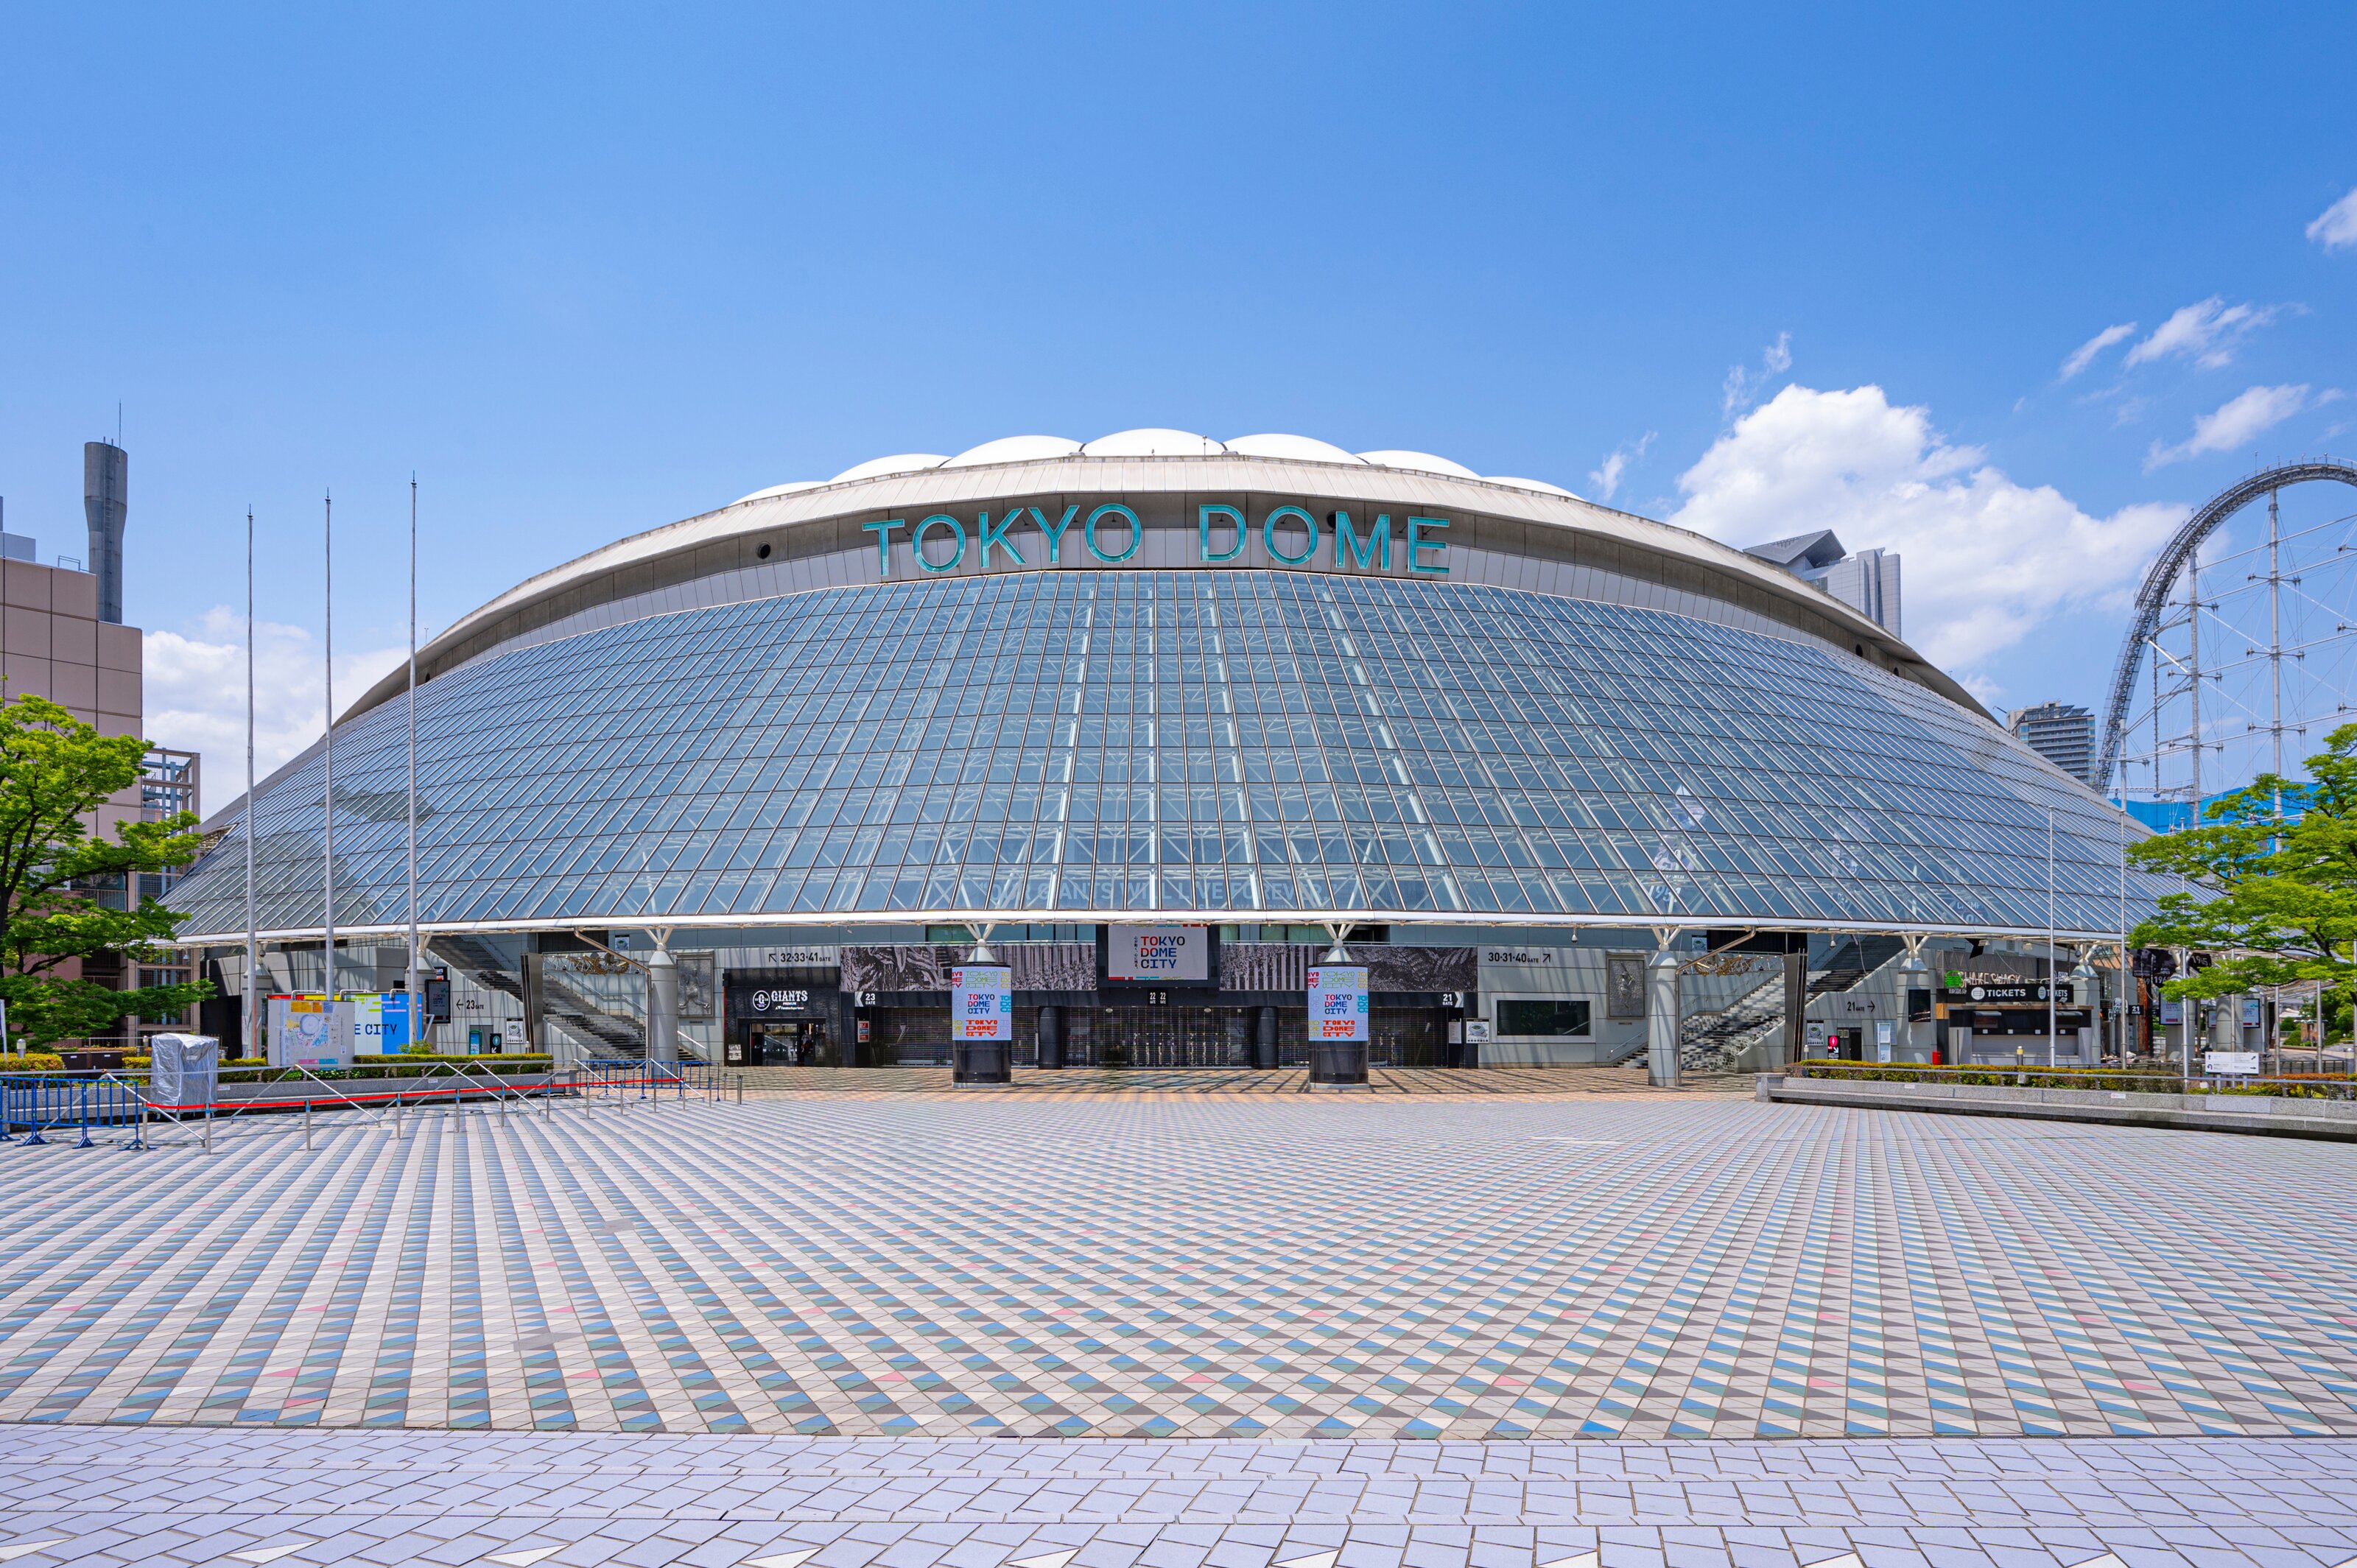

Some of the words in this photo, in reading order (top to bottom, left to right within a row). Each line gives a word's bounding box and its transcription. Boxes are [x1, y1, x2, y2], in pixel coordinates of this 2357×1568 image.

[862, 503, 1141, 575] TOKYO
[1199, 504, 1450, 574] DOME
[1038, 882, 1112, 900] GANTS
[1141, 936, 1185, 946] TOKYO
[1141, 948, 1177, 957] DOME
[1141, 959, 1177, 968] CITY
[771, 991, 808, 1002] GIANTS
[466, 999, 475, 1010] 23
[1847, 1002, 1855, 1011] 21
[365, 1024, 397, 1035] CITY
